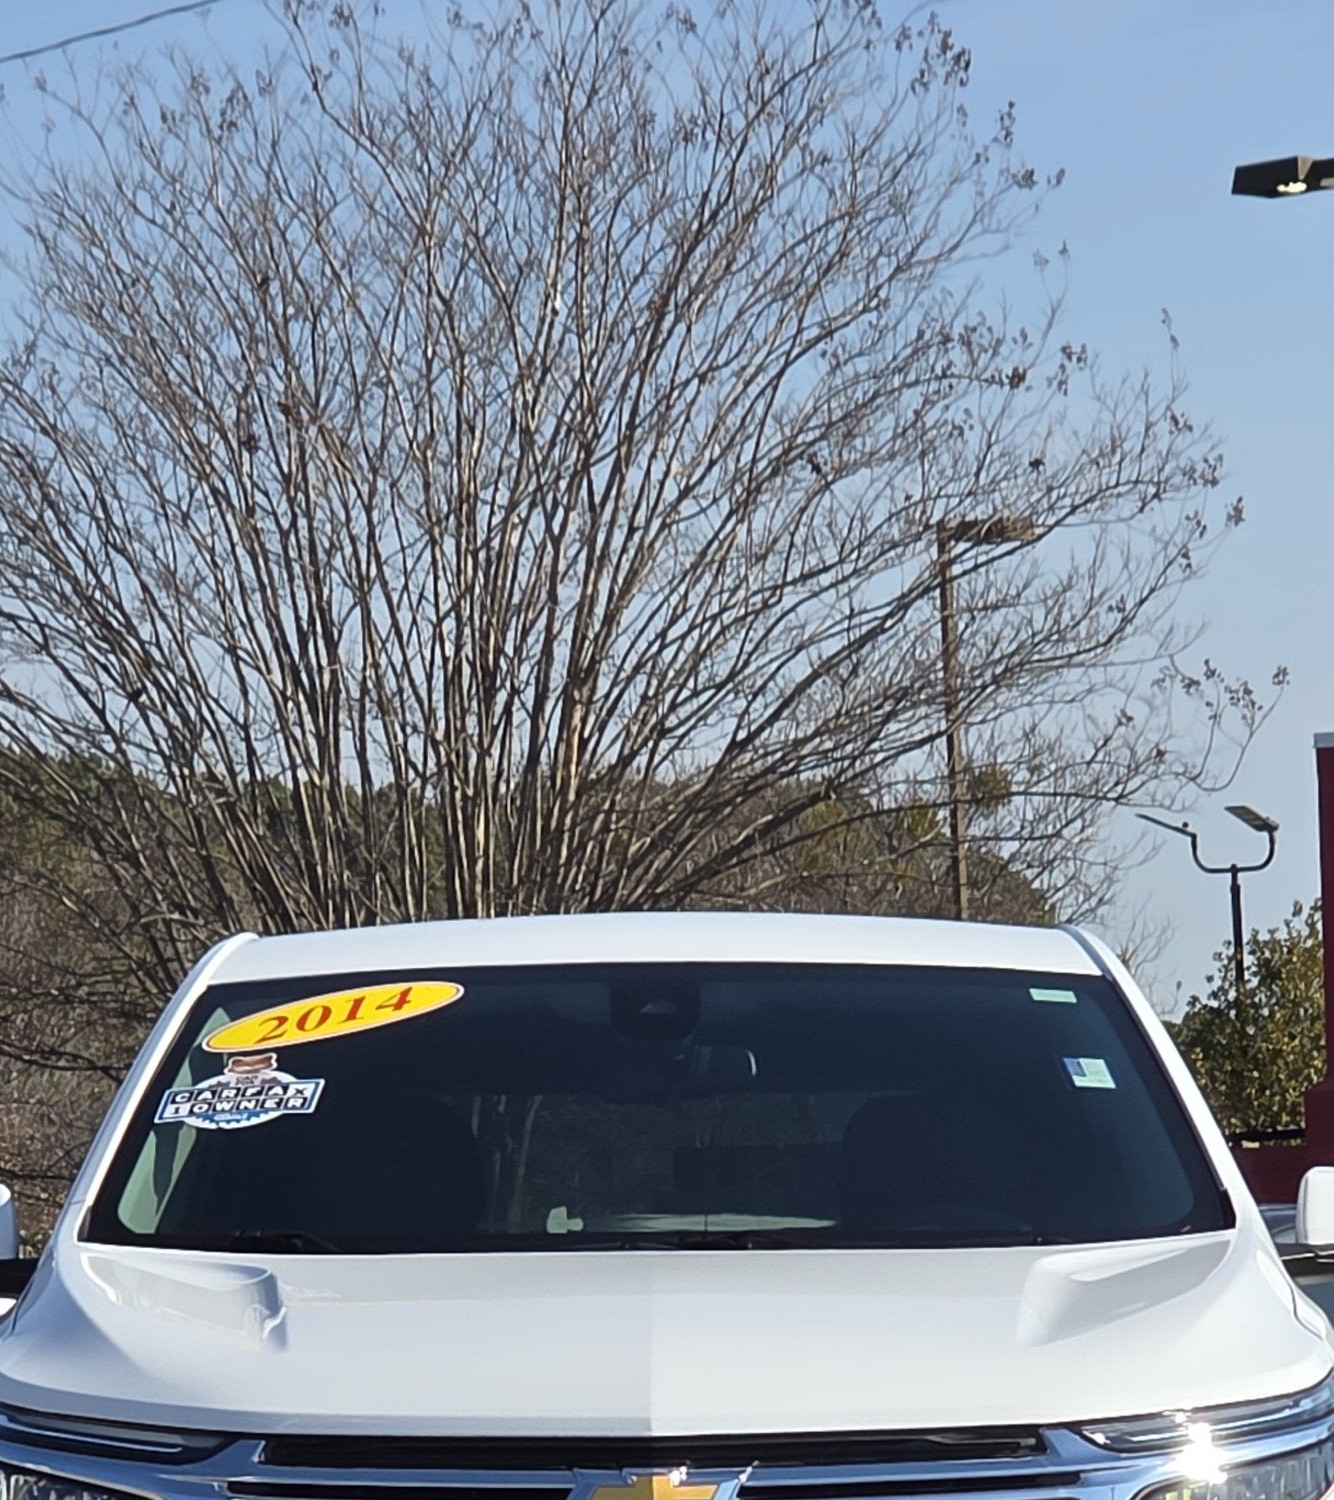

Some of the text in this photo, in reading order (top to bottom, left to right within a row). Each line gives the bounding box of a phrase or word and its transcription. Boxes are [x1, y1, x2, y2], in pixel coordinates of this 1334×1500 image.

[253, 986, 414, 1045] 2014
[174, 1086, 309, 1103] CARFAX
[192, 1098, 305, 1112] OWNER
